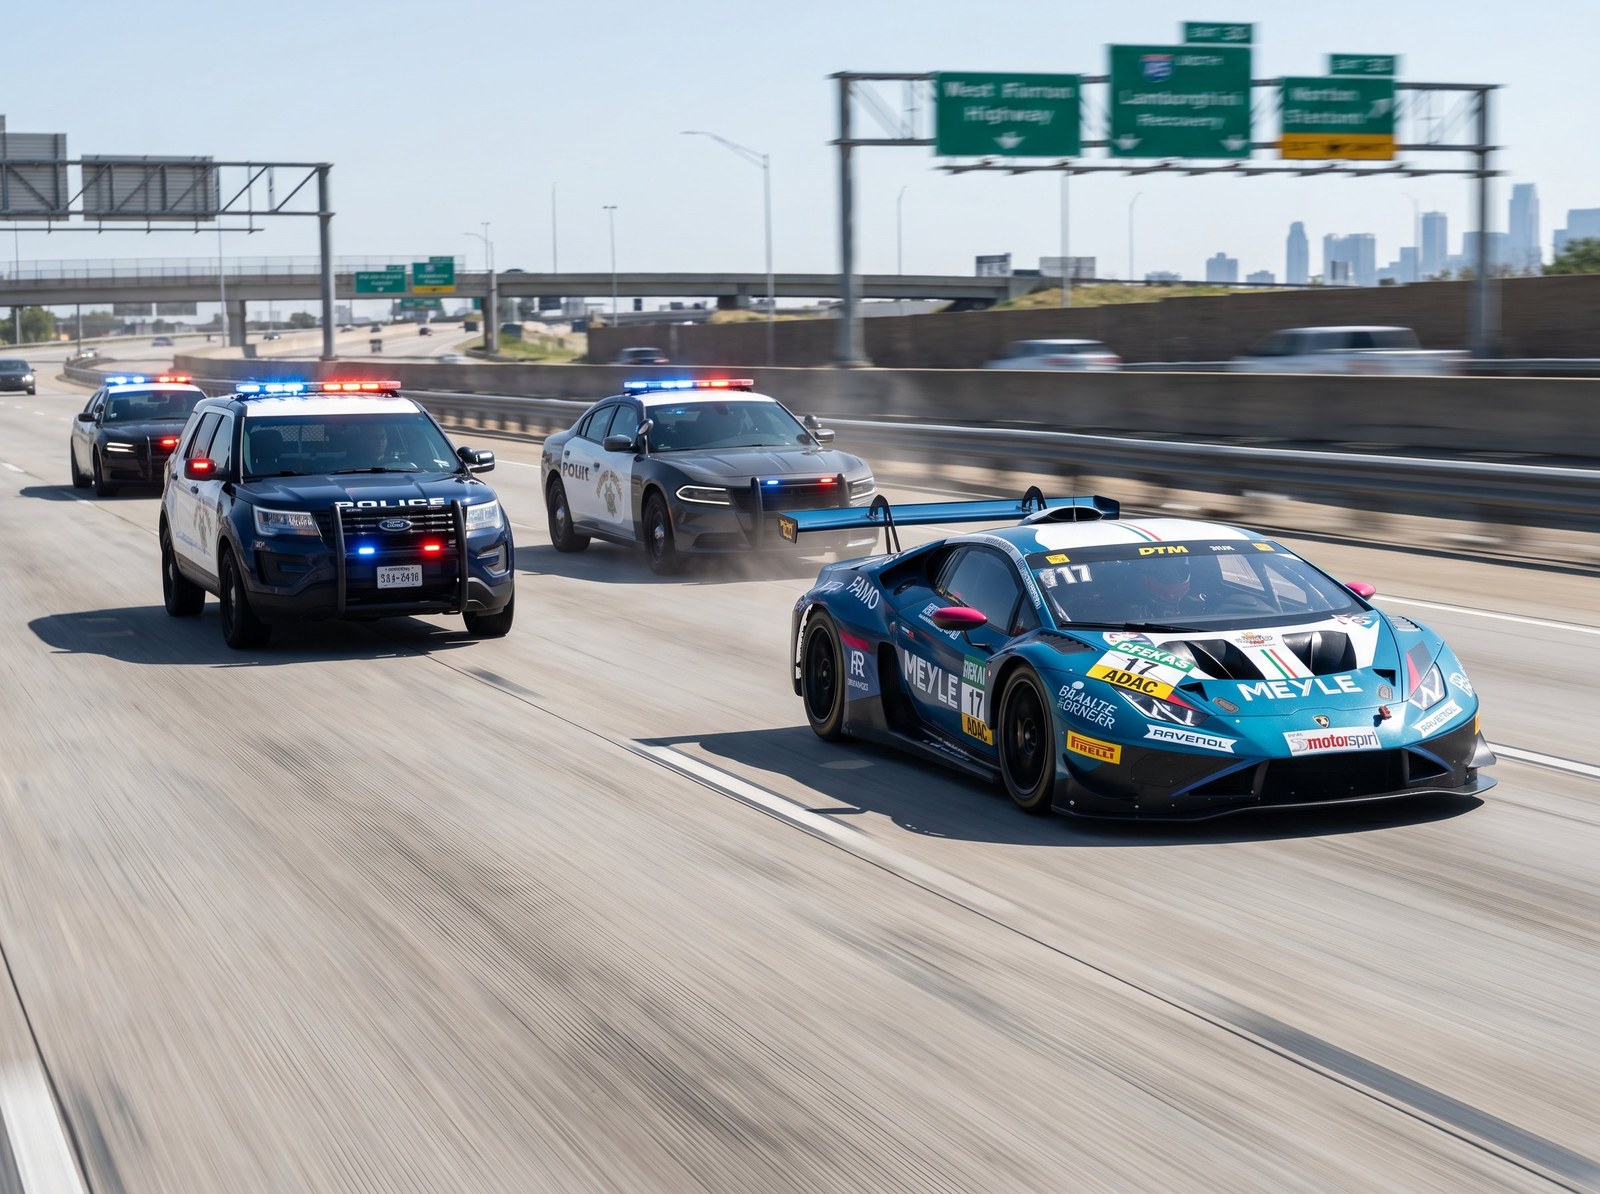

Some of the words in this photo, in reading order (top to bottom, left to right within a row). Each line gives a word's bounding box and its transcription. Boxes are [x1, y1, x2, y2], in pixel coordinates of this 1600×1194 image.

[334, 497, 445, 508] POLICE
[1138, 545, 1189, 556] DTM
[846, 575, 880, 610] FAMO
[1124, 657, 1160, 676] 17
[904, 650, 959, 709] MEYLE
[1102, 669, 1159, 694] ADAC
[1236, 675, 1364, 702] MEYLE
[969, 688, 985, 719] 17
[966, 717, 988, 742] ADAC
[1070, 735, 1116, 760] PIRELLI
